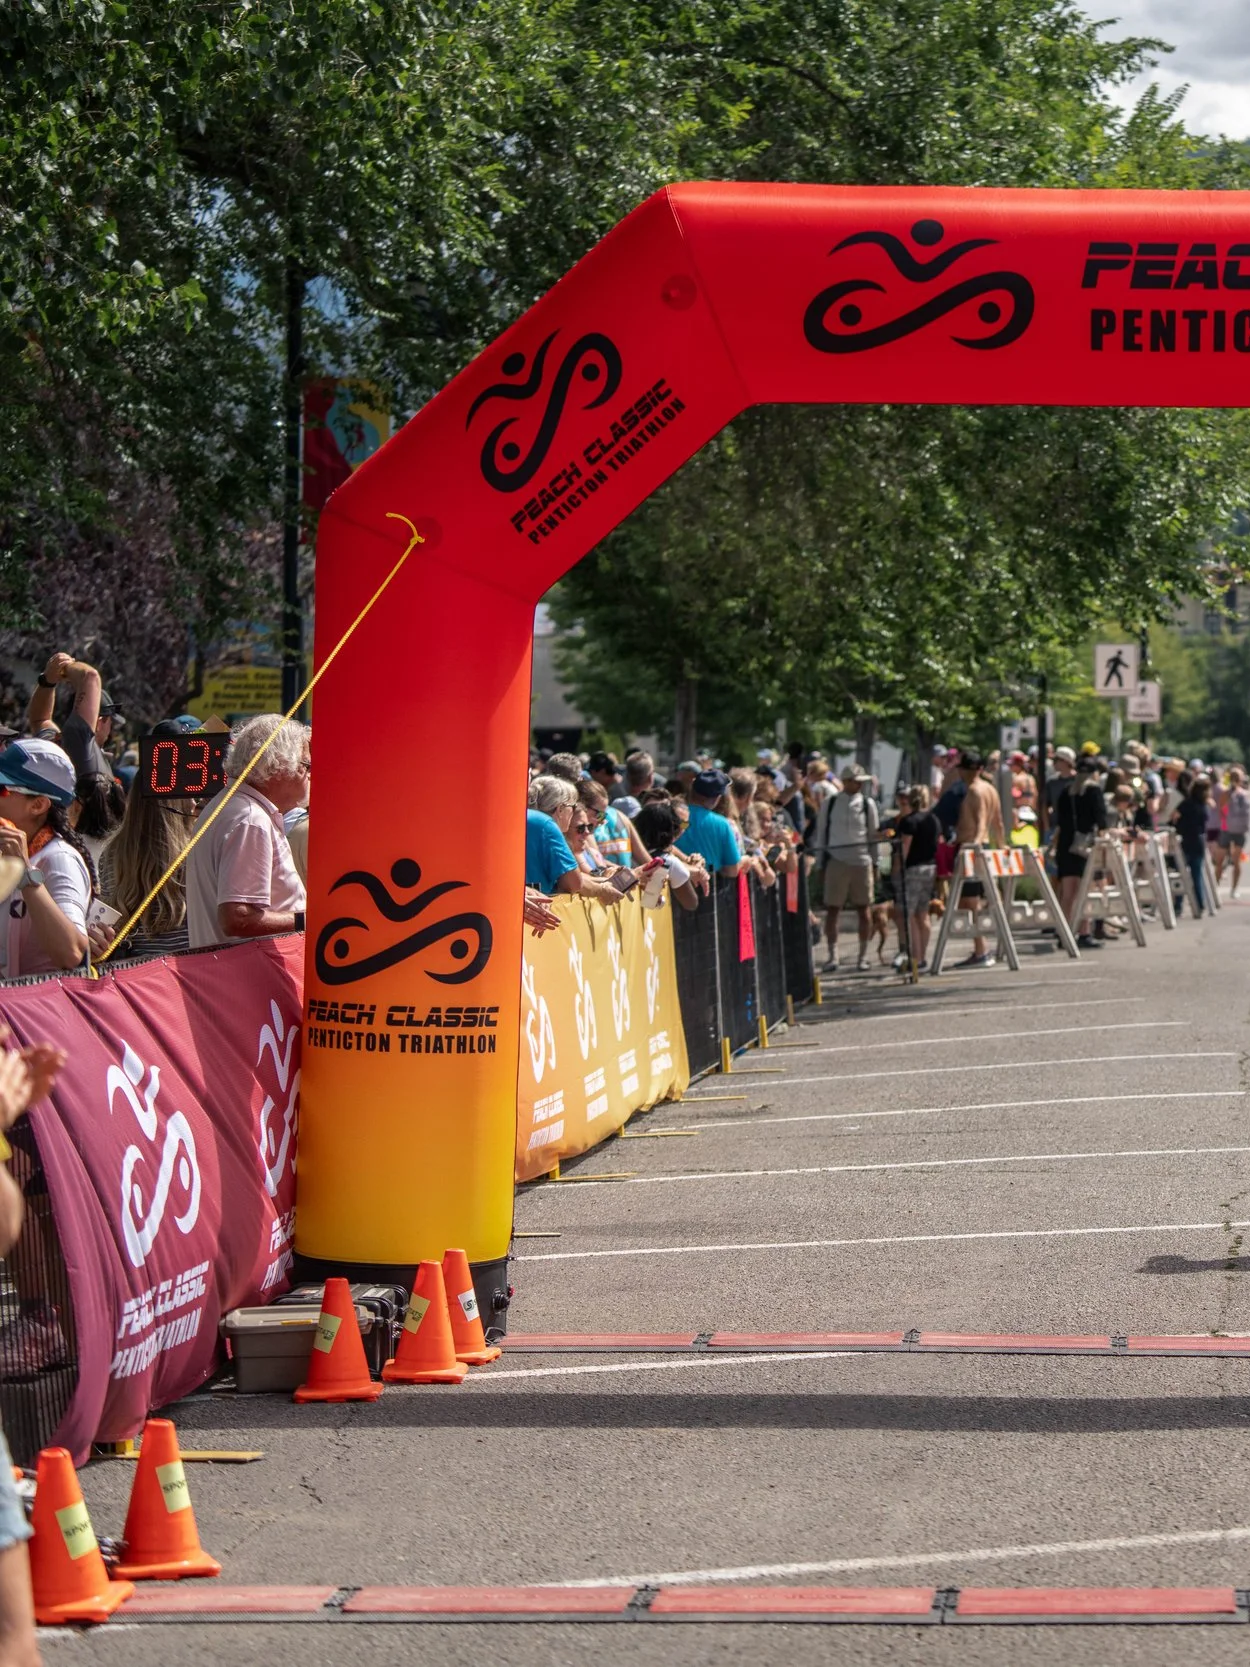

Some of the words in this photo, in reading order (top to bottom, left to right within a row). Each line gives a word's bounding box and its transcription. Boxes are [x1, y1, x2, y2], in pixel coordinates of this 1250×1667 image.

[510, 461, 583, 534] PEACH
[582, 378, 673, 466] CLASSIC
[528, 469, 609, 545] PENTICTON
[606, 397, 686, 471] TRIATHLON
[151, 740, 228, 793] 03:
[307, 998, 377, 1026] PEACH
[386, 1005, 500, 1028] CLASSIC
[308, 1026, 391, 1053] PENTICTON
[398, 1033, 497, 1054] TRIATHLON
[117, 1286, 157, 1339] PEAC
